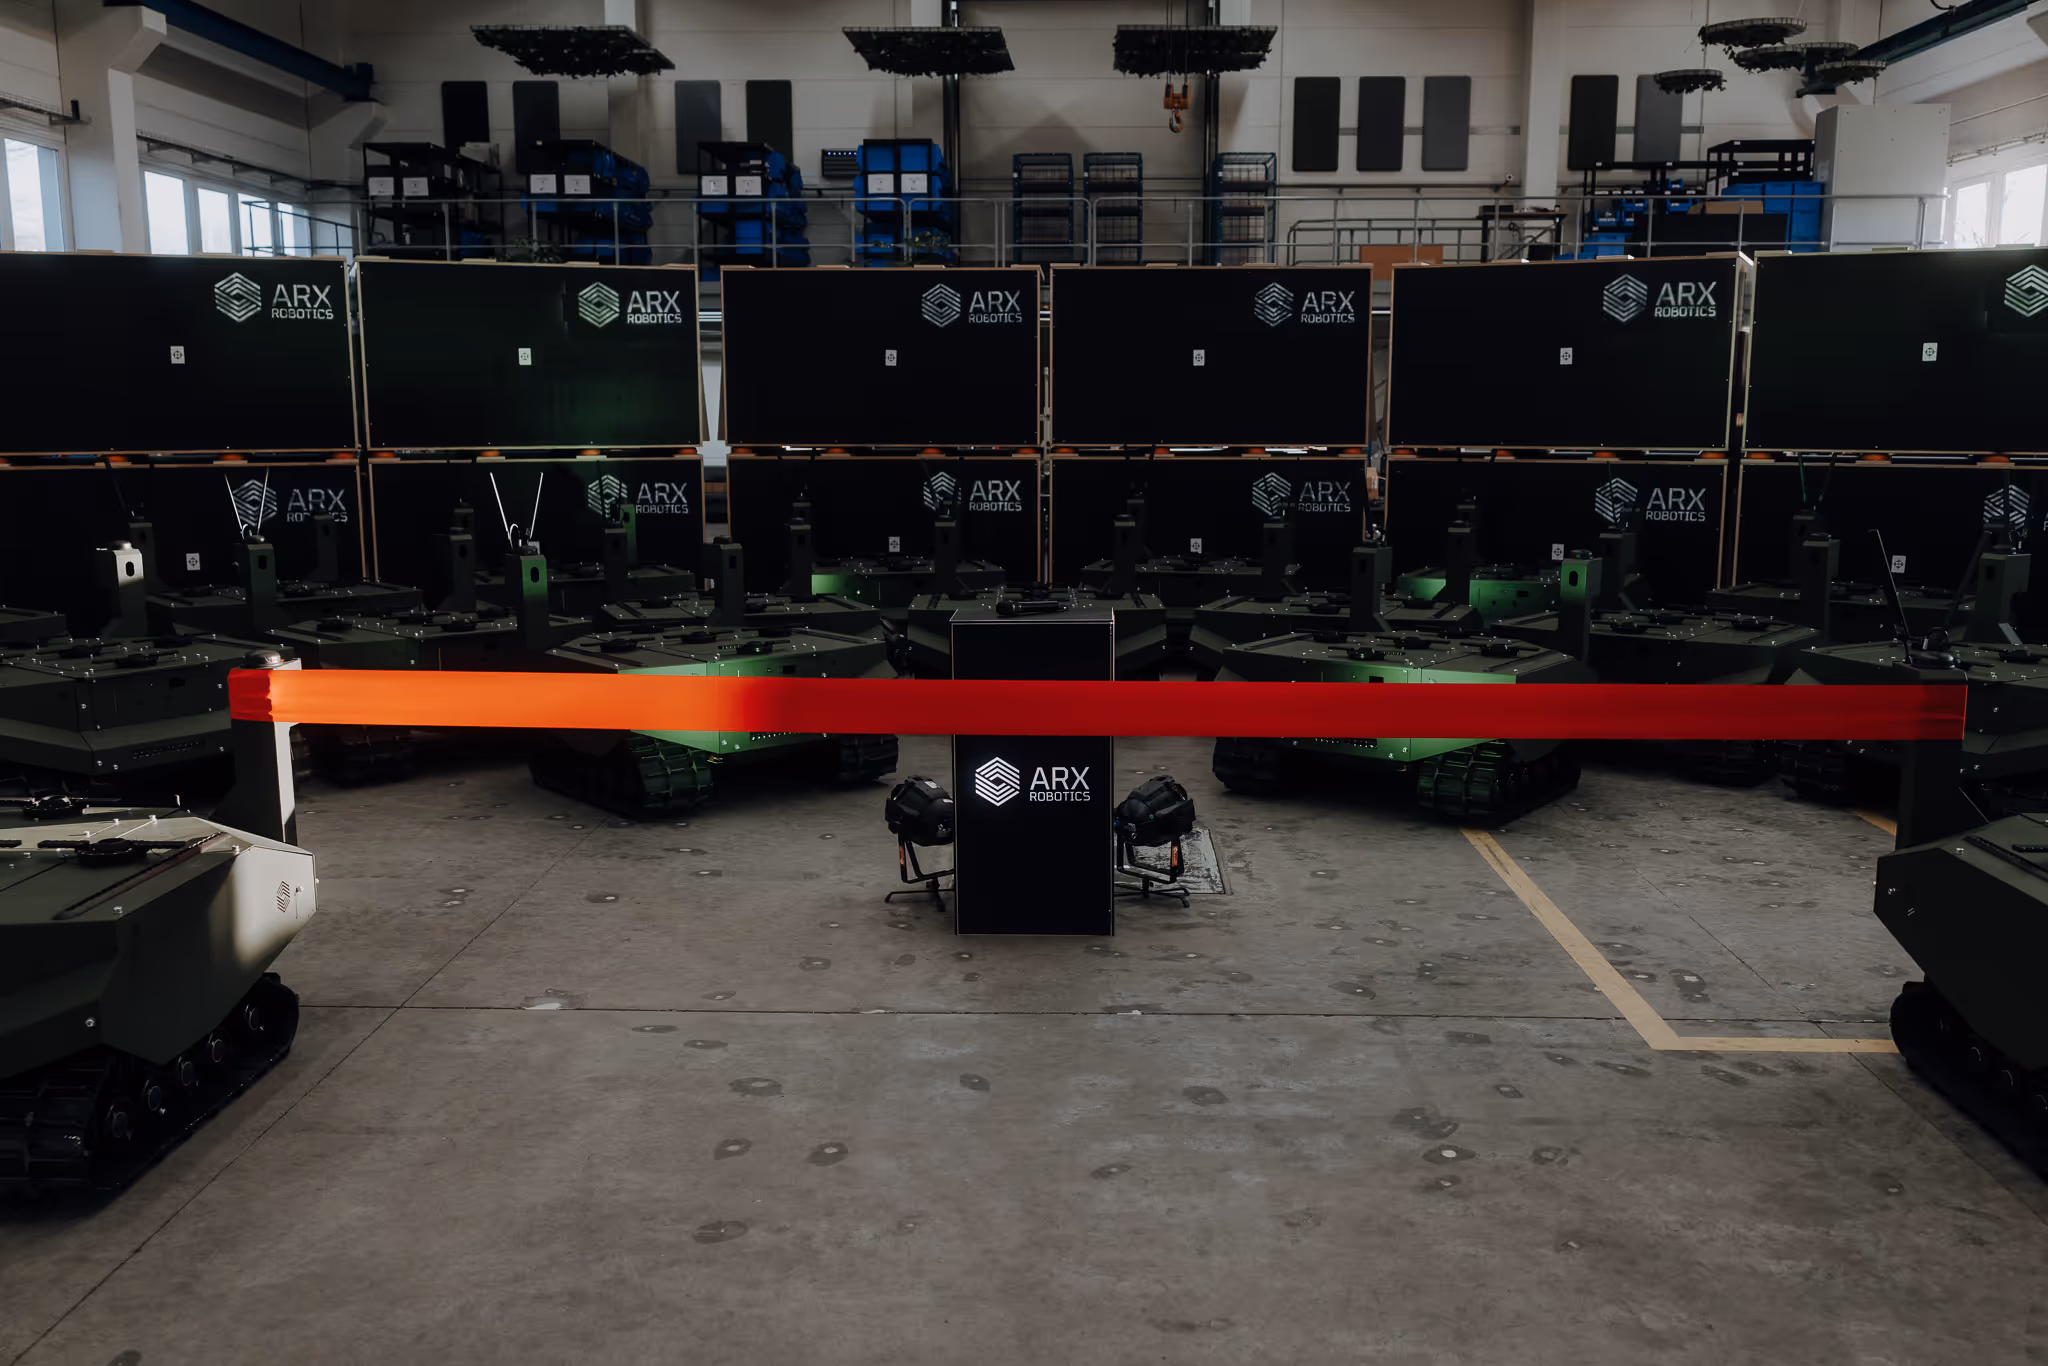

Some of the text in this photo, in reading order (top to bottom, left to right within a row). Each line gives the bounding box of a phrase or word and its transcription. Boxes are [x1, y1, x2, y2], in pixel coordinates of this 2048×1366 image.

[272, 283, 332, 307] ARX
[968, 290, 1021, 312] ARX
[1301, 290, 1355, 312] ARX
[1655, 281, 1717, 305] ARX
[626, 290, 681, 313] ARX
[271, 308, 334, 320] ROBOTICS
[627, 314, 682, 324] ROBOTICS
[968, 313, 1023, 324] ROBOTICS
[1300, 314, 1355, 324] ROBOTICS
[1654, 307, 1717, 318] ROBOTICS
[636, 482, 688, 503] ARX
[969, 479, 1021, 501] ARX
[1298, 481, 1351, 502] ARX
[287, 488, 346, 510] ARX
[1646, 487, 1707, 510] ARX
[635, 505, 689, 514] ROBOTICS
[969, 502, 1022, 512] ROBOTICS
[1298, 503, 1351, 513] ROBOTICS
[286, 512, 349, 523] ROCS
[1645, 511, 1706, 522] ROBOTICS
[1029, 766, 1090, 790] ARX
[1029, 792, 1091, 802] ROBOTICS
